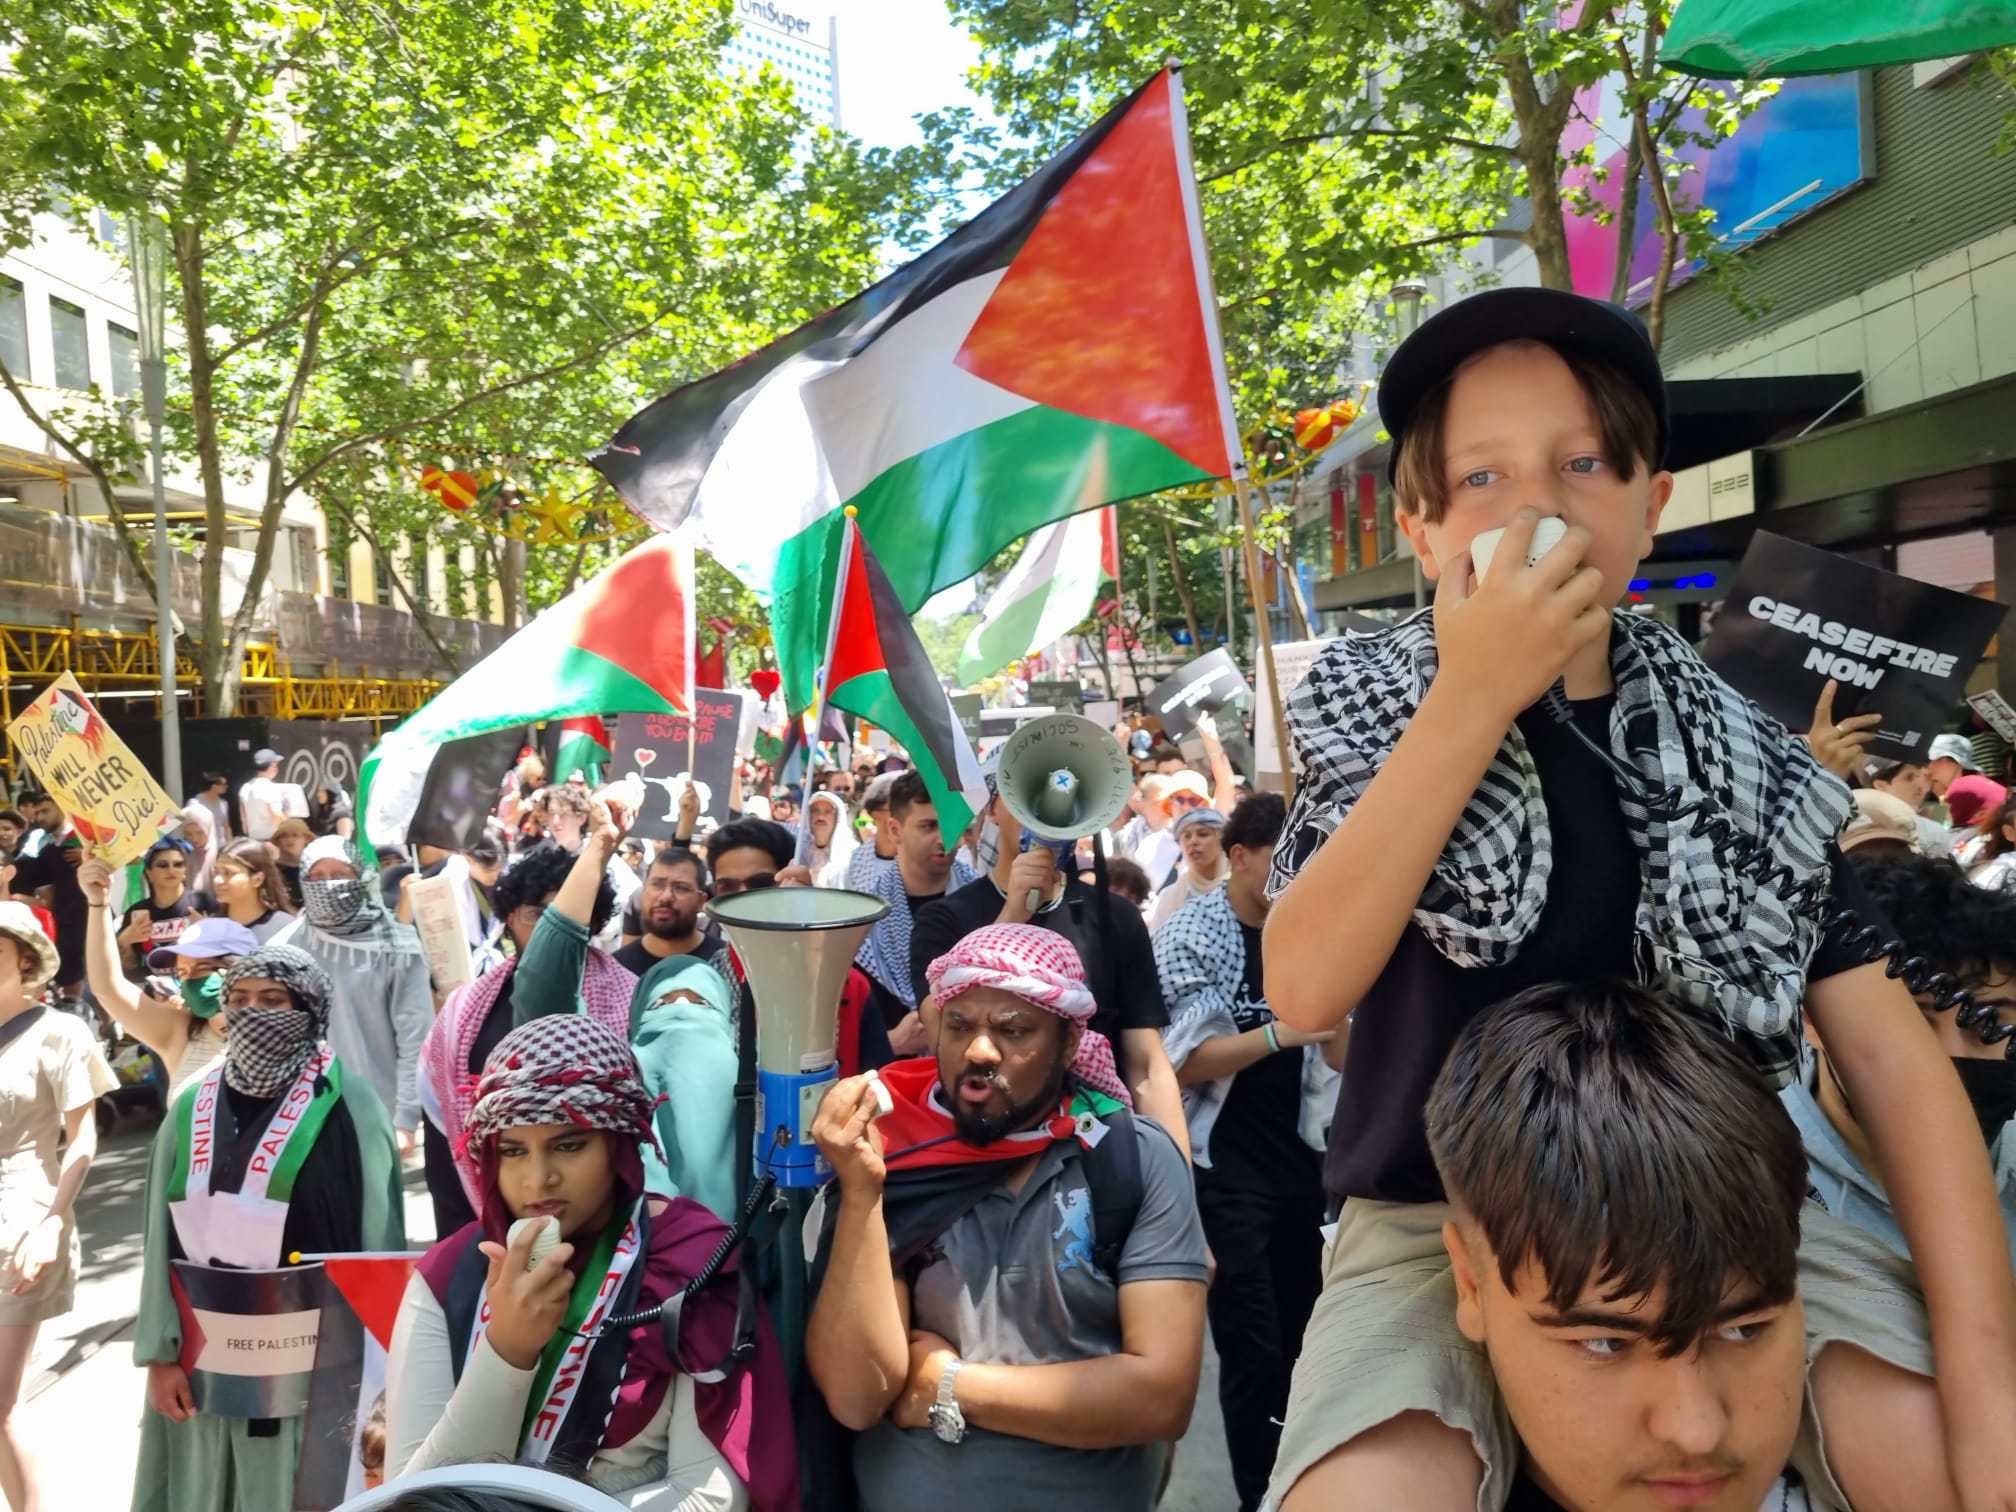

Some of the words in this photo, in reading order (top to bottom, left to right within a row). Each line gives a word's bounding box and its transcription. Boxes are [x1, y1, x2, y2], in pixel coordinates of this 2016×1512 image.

[740, 0, 811, 34] UniSuper
[1748, 596, 1958, 678] CEASEFIRE
[1803, 646, 1885, 690] NOW
[19, 701, 79, 777] Palestine
[51, 753, 87, 789] WILL
[72, 755, 134, 812] NEVER
[112, 778, 160, 837] Die!
[191, 1066, 219, 1176] LESTINE
[227, 1338, 254, 1351] FREE
[258, 1333, 320, 1351] PALESTIN
